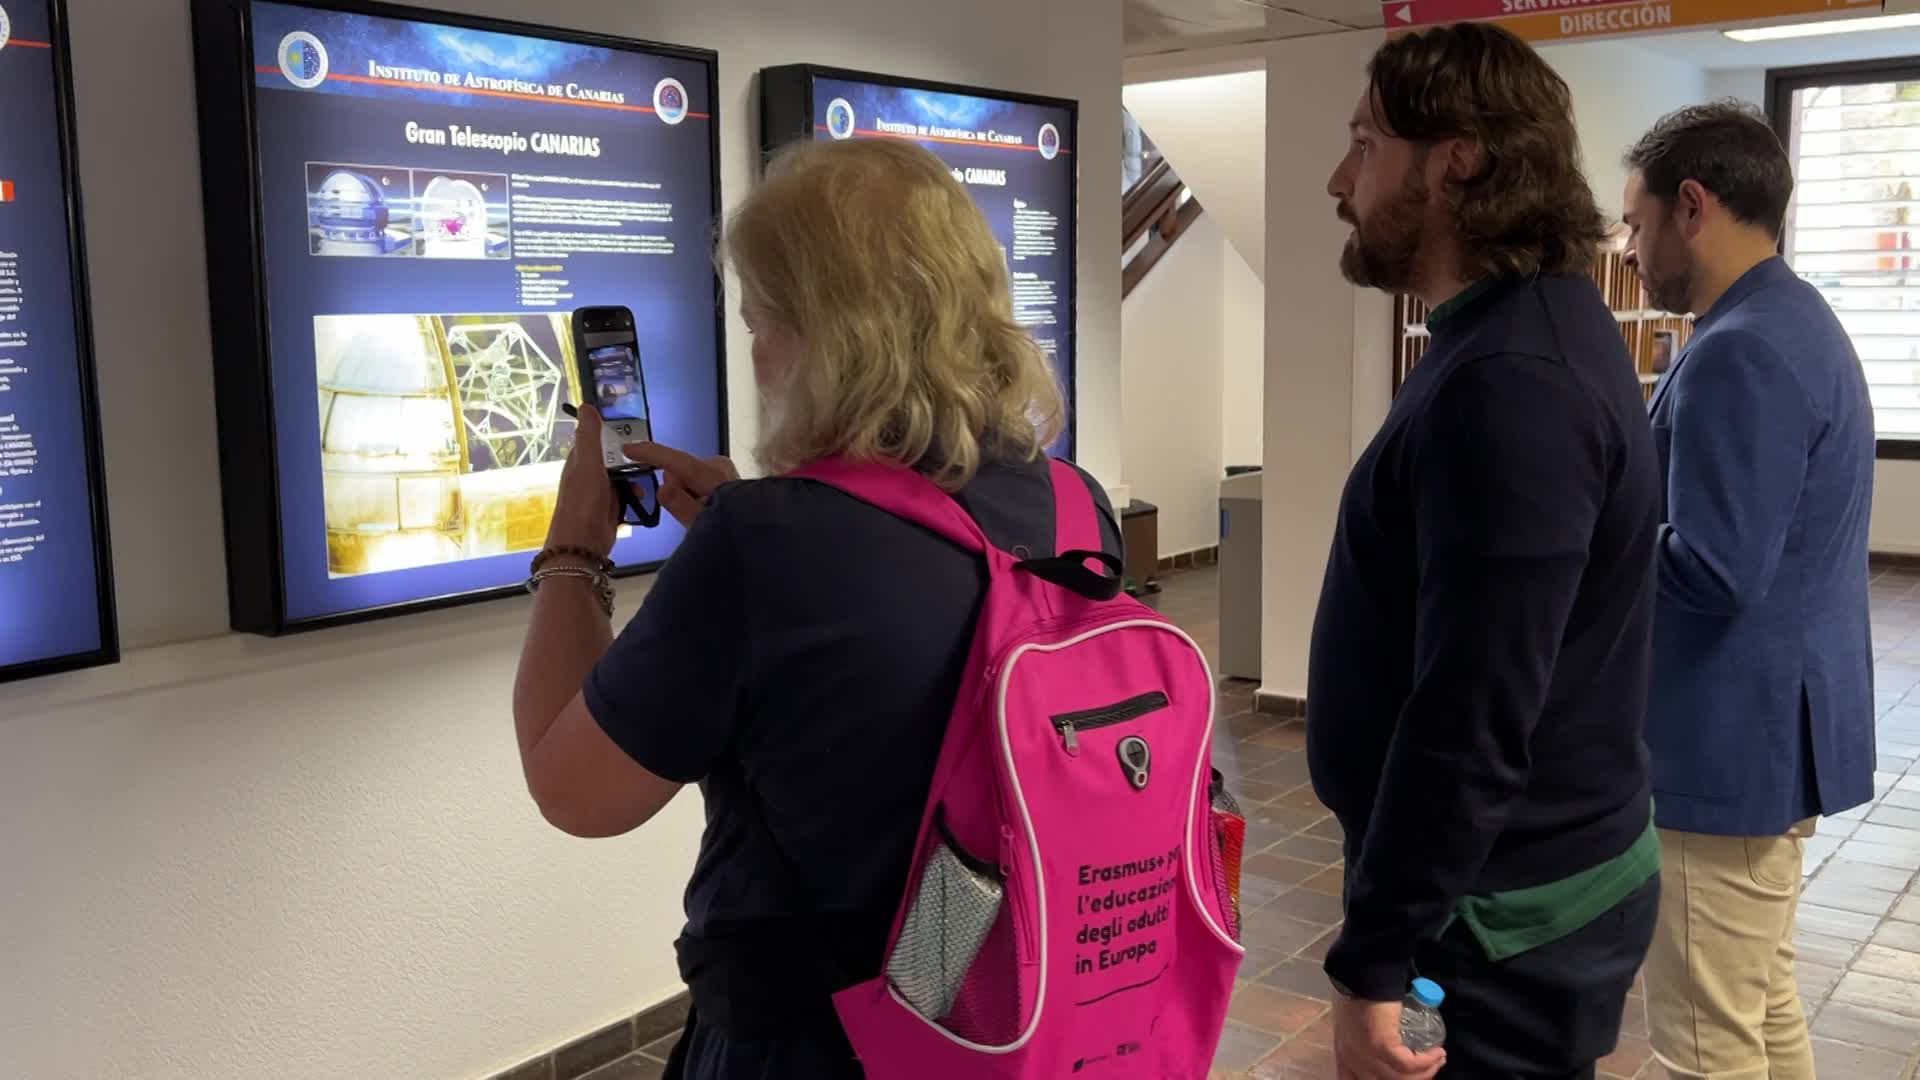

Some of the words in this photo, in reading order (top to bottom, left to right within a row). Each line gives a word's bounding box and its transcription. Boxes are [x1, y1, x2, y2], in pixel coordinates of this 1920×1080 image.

[1559, 3, 1671, 34] DIRECCIÓN
[368, 60, 441, 84] INSTITUTO
[443, 72, 461, 86] DE
[566, 84, 625, 104] CANARIAS
[405, 121, 445, 145] Gran
[448, 125, 528, 155] Telescopio
[530, 133, 601, 157] CANARIAS
[1078, 856, 1164, 885] Erasmus+
[1076, 916, 1123, 945] degli
[1075, 953, 1093, 976] in
[1099, 939, 1157, 971] Europa
